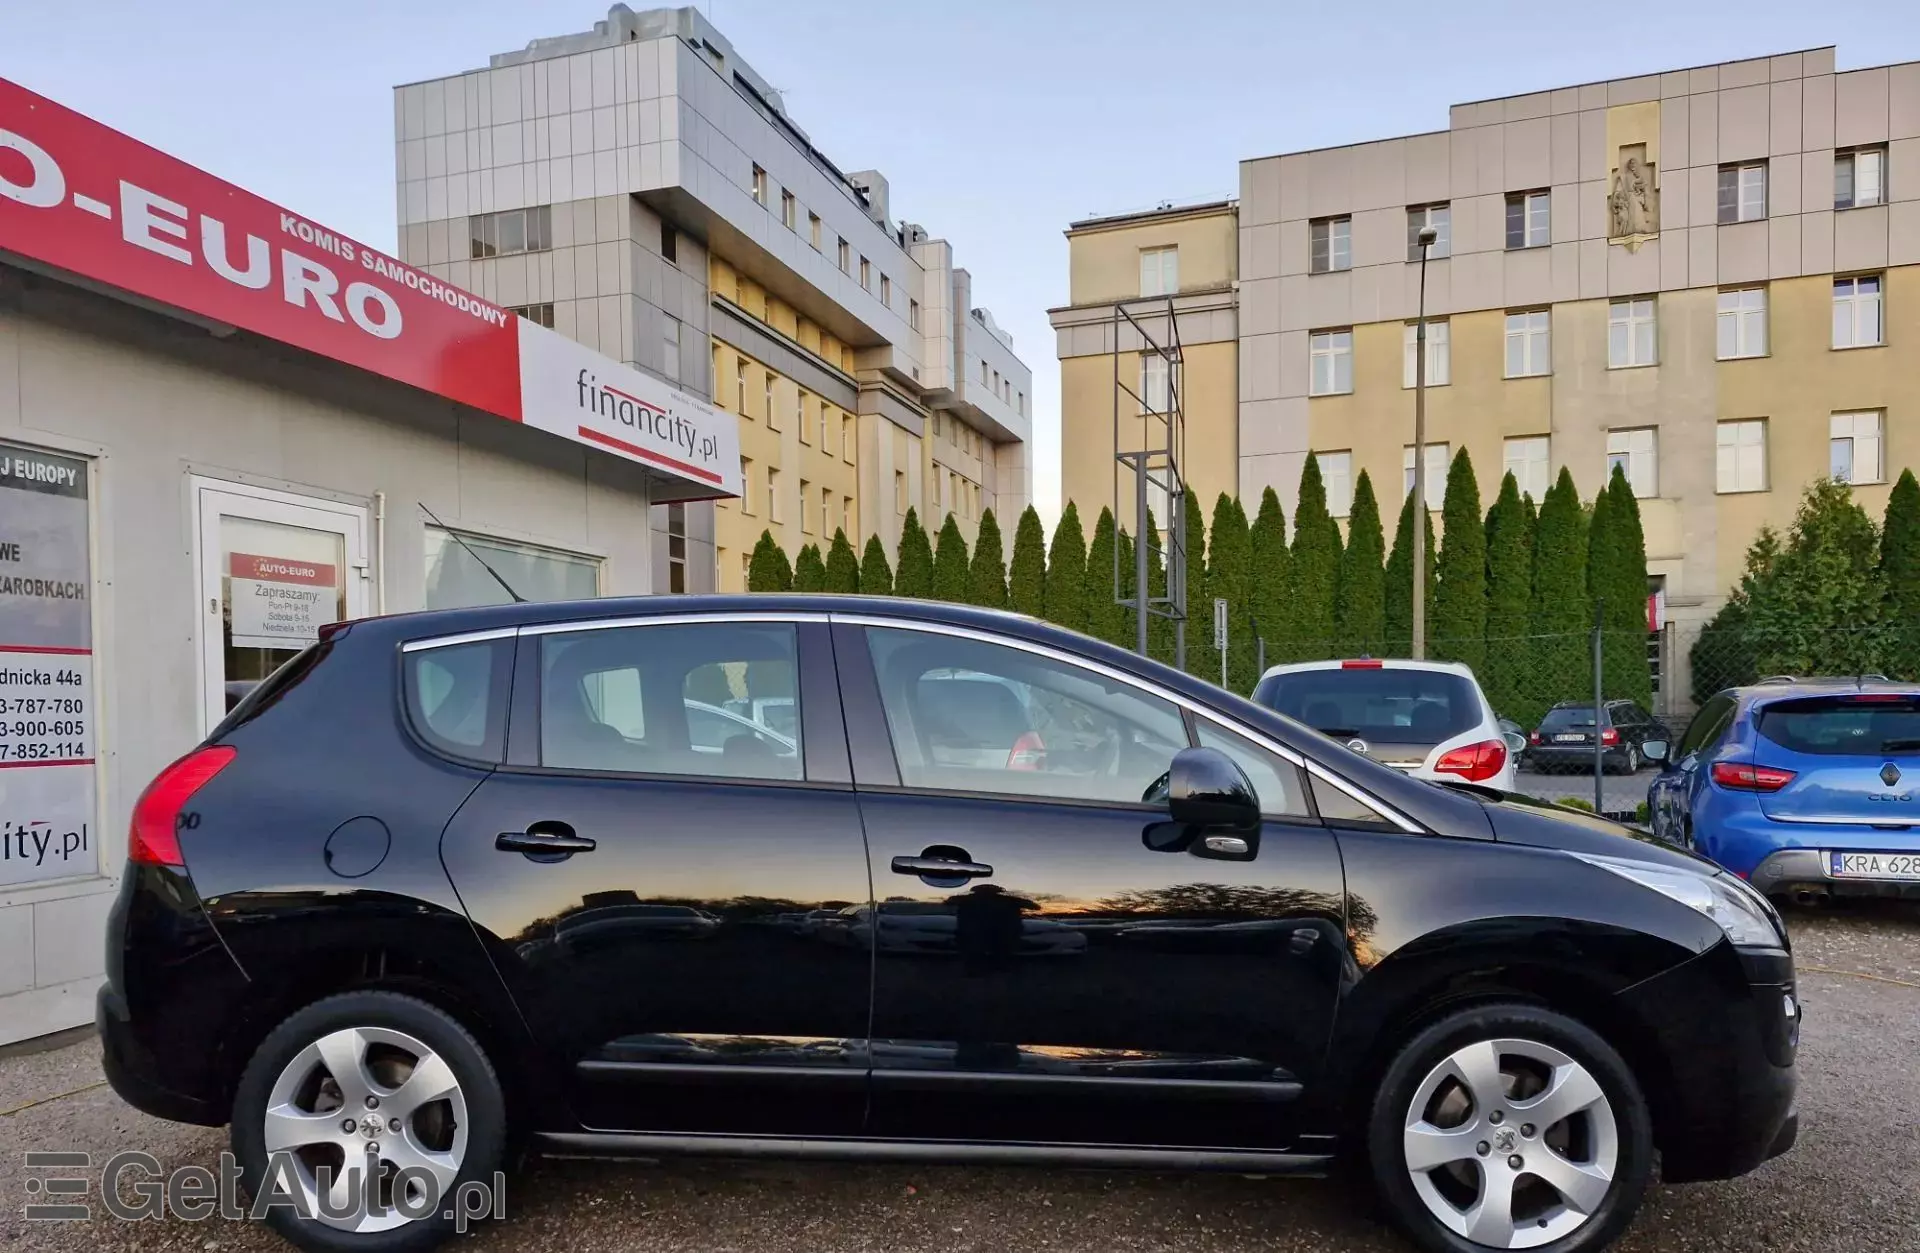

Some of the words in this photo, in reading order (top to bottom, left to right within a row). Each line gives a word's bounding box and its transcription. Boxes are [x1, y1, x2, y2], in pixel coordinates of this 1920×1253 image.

[280, 213, 355, 260] KOMIS
[361, 251, 509, 328] SAMOCHODOWY
[577, 368, 718, 462] financity.pl
[15, 459, 77, 487] EUROPY
[259, 563, 316, 578] AUTO-EURO
[0, 576, 85, 600] AROBKACH
[268, 612, 293, 622] Sobota
[262, 622, 295, 633] Niedziela
[0, 667, 51, 686] dnicka
[56, 669, 82, 686] 44a
[0, 698, 83, 714] 3-787-780
[0, 721, 84, 736] 3-900-605
[0, 742, 85, 759] 7-852-114
[1867, 793, 1912, 802] CLIO
[1843, 855, 1881, 873] KRA
